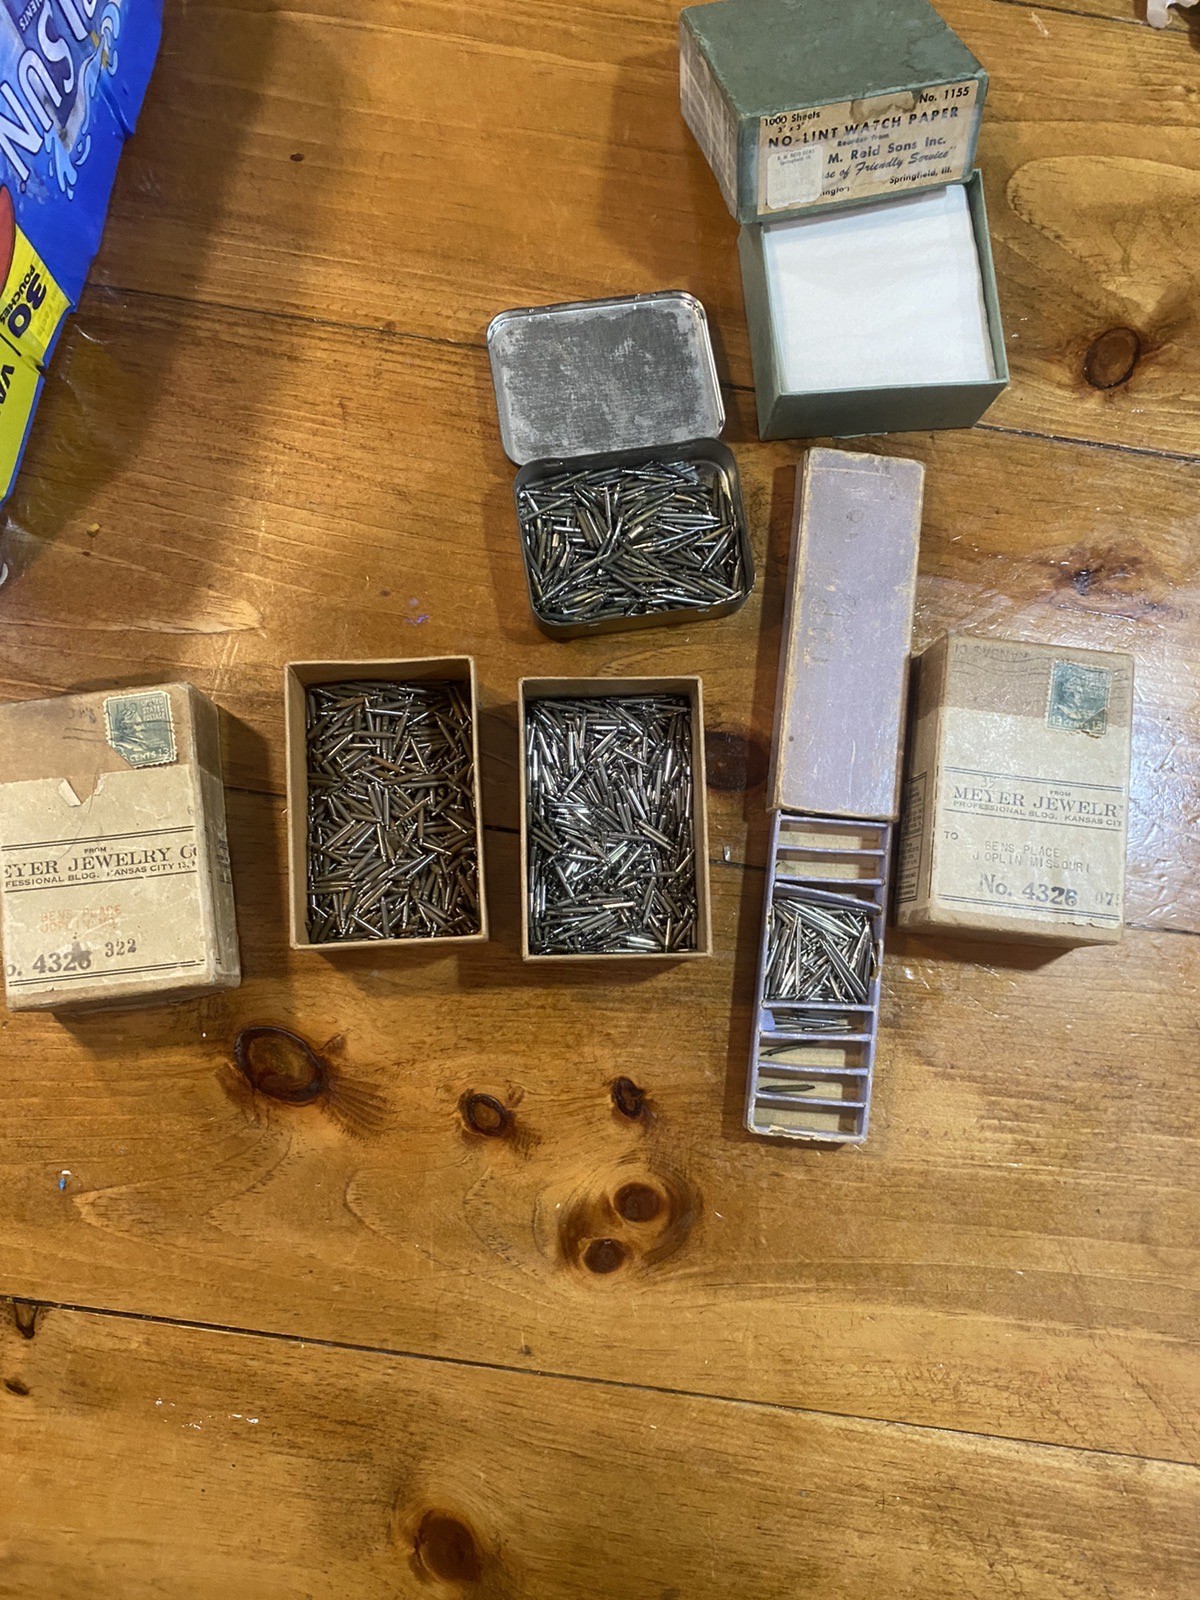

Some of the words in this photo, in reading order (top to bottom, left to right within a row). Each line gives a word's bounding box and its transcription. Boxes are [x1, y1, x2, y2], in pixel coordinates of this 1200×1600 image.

[919, 93, 938, 104] No.
[944, 86, 970, 100] 1155
[764, 115, 788, 127] 1000
[791, 111, 821, 123] Sheets
[768, 127, 839, 148] NO-LINT
[844, 115, 902, 136] WATCH
[908, 106, 959, 126] PAPER
[828, 153, 843, 165] M.
[850, 145, 881, 161] Reid
[887, 142, 917, 154] Sons
[925, 136, 947, 148] Inc.
[839, 165, 852, 180] of
[855, 157, 904, 177] Friendly
[7, 272, 47, 339] 30
[953, 786, 1026, 808] MEYER
[953, 800, 1026, 817] PROFESSIONAL
[1064, 814, 1104, 825] KANSAS
[944, 830, 959, 841] TO
[68, 847, 171, 872] JEWELRY
[84, 846, 107, 854] FROM
[1023, 844, 1060, 858] PLACE
[5, 876, 64, 888] FESSIONAL
[149, 862, 175, 873] CITY
[1030, 856, 1090, 873] MISSOURI
[979, 872, 1013, 897] No.
[105, 938, 137, 957] 322
